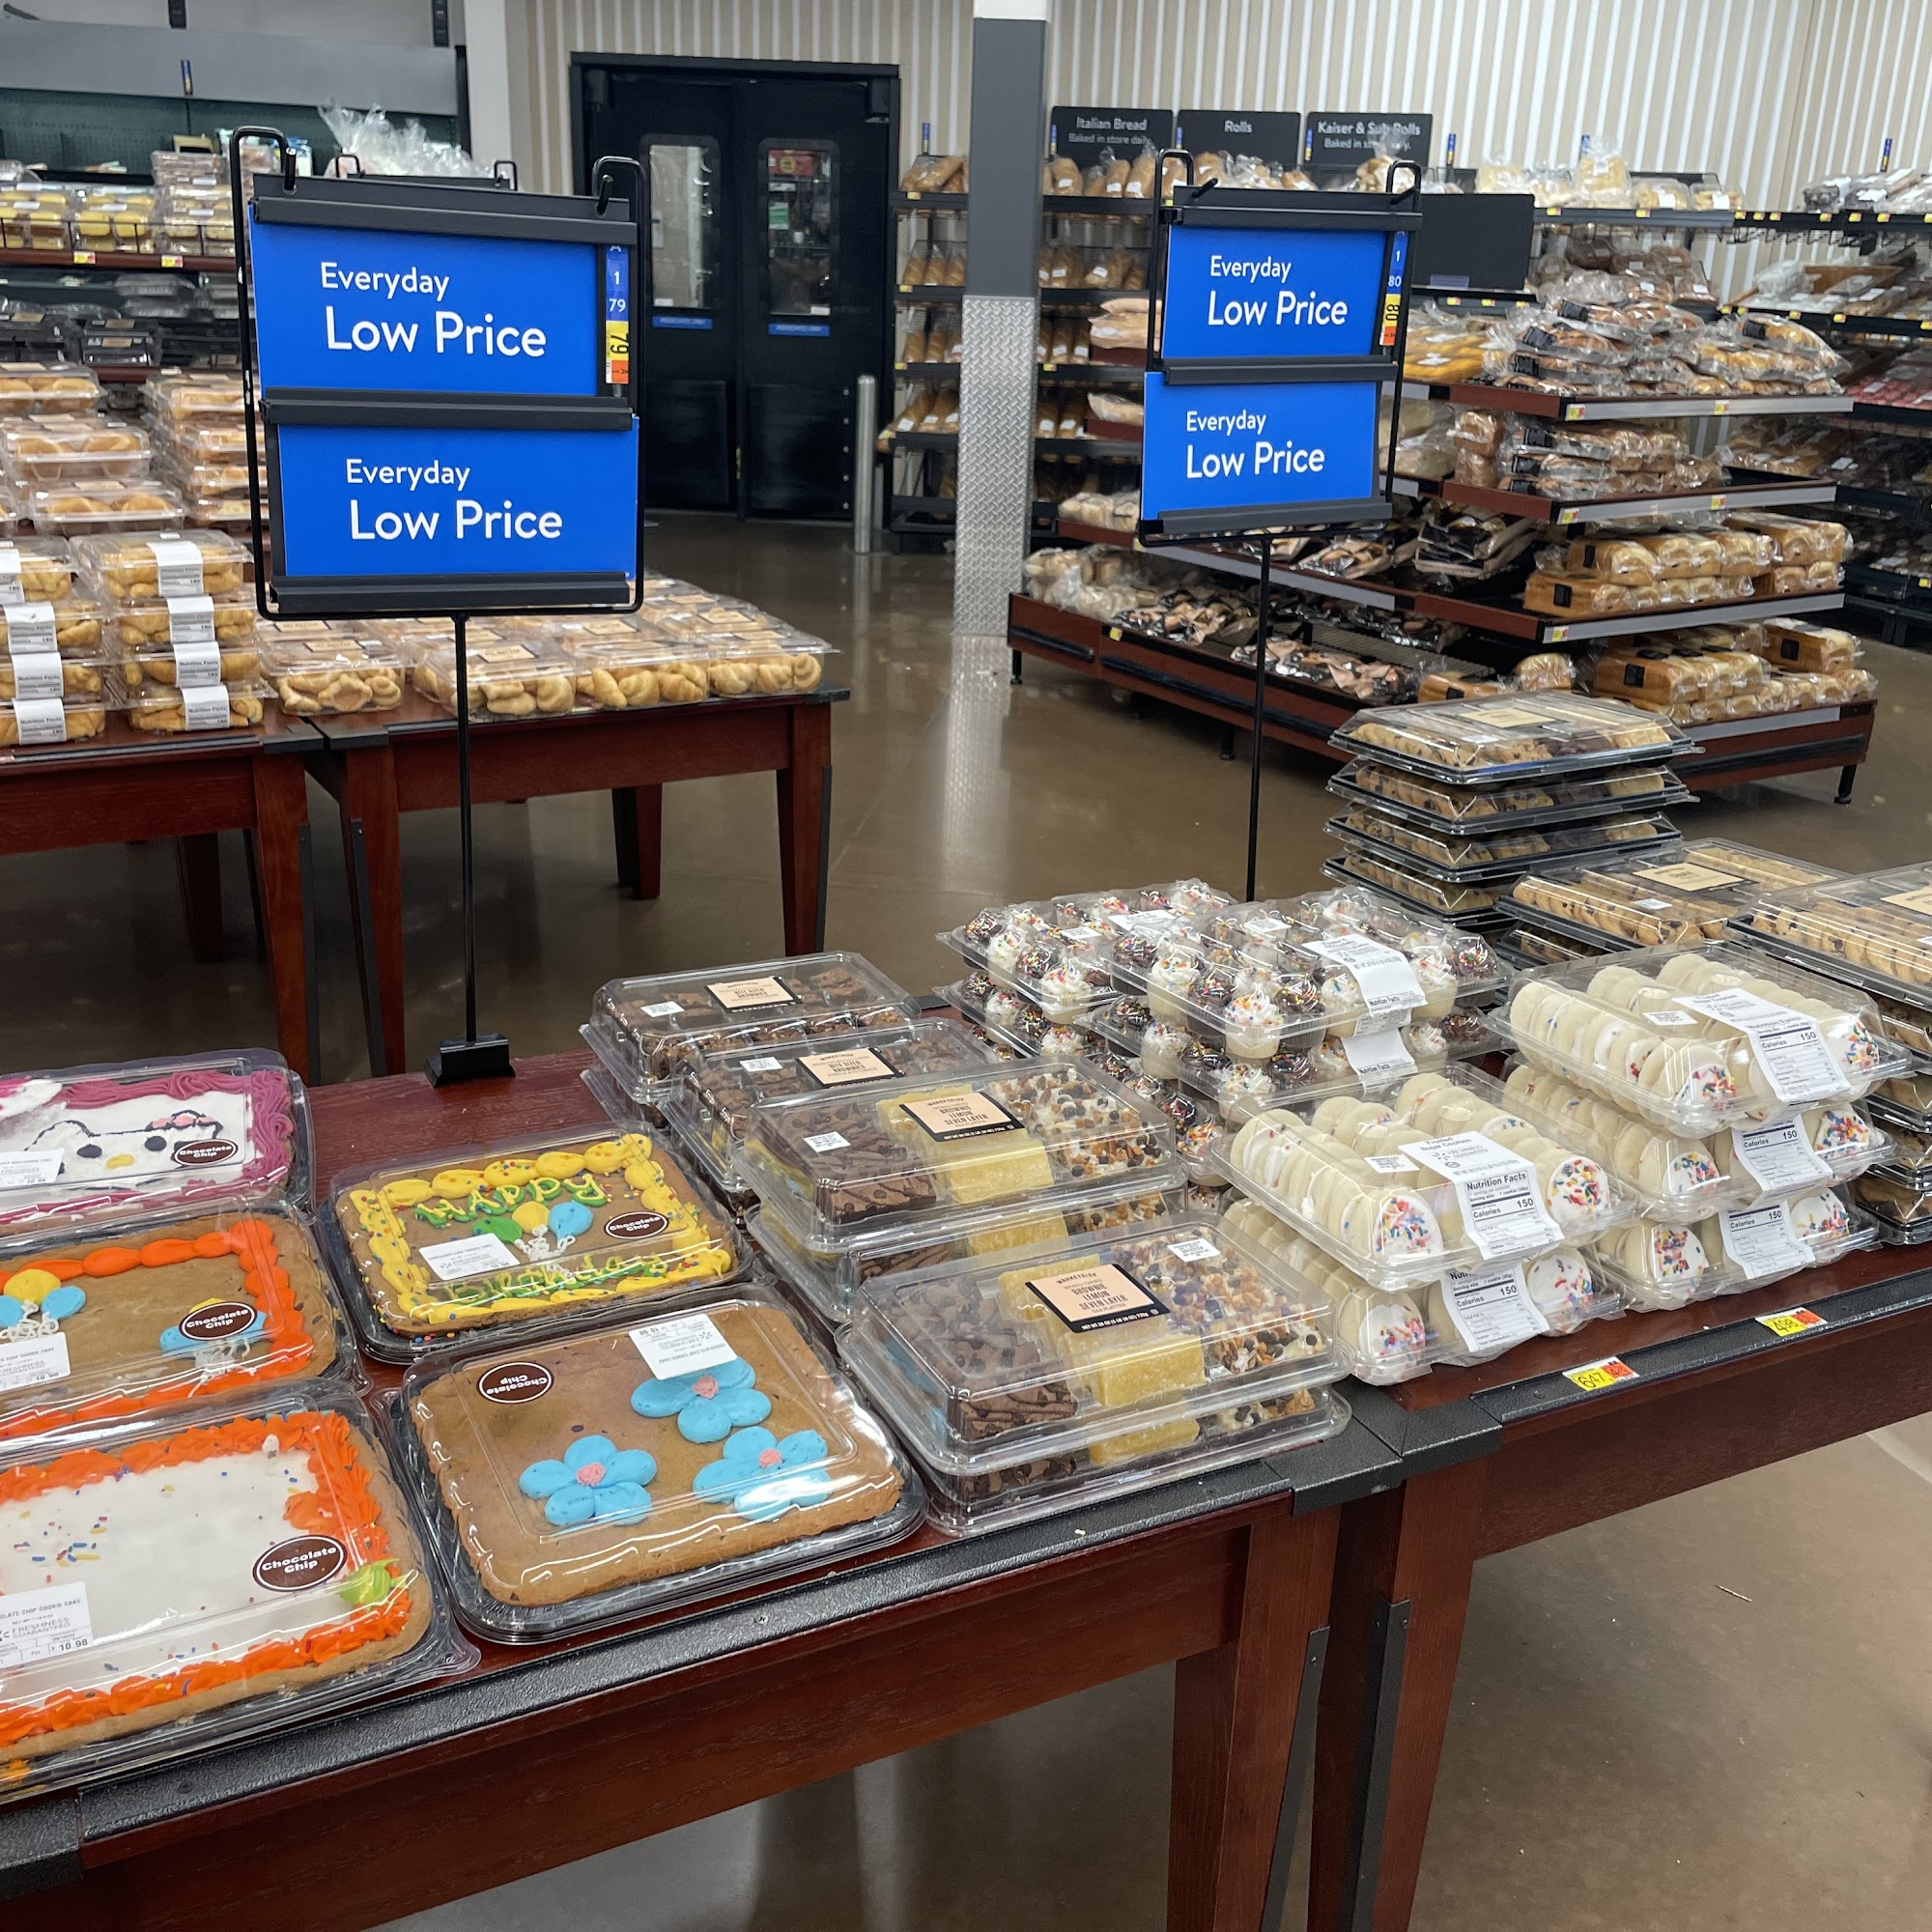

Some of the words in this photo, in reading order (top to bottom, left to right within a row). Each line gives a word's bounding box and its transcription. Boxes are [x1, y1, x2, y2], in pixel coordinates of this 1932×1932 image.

[1076, 116, 1111, 129] Italian
[1114, 118, 1148, 130] Bread
[1224, 120, 1253, 133] Rolls
[1318, 120, 1353, 134] Kaiser
[1355, 121, 1365, 134] &
[1392, 122, 1421, 135] Rolls
[1209, 255, 1293, 283] Everyday
[321, 261, 449, 301] Everyday
[613, 270, 620, 285] 1
[1388, 275, 1402, 287] 80
[609, 298, 626, 312] 79
[1208, 290, 1268, 326] Low
[1275, 290, 1349, 326] Price
[325, 305, 419, 354] Low
[435, 310, 548, 357] Price
[1186, 409, 1267, 437] Everyday
[1186, 444, 1245, 478] Low
[1254, 440, 1325, 474] Price
[346, 458, 470, 491] Everyday
[350, 498, 440, 541] Low
[455, 499, 563, 540] Price
[1762, 1040, 1787, 1049] Calories
[1800, 1032, 1816, 1040] 150
[939, 1104, 971, 1115] BROWNIE
[948, 1109, 974, 1119] LEMON
[944, 1116, 968, 1125] SEVEN
[967, 1113, 989, 1122] LAYER
[1743, 1138, 1769, 1149] Calories
[1782, 1129, 1798, 1139] 150
[180, 1146, 232, 1156] Chocolate
[1466, 1178, 1502, 1191] Nutrition
[1503, 1172, 1526, 1183] Facts
[1473, 1208, 1501, 1218] Calories
[1517, 1198, 1534, 1208] 150
[609, 1215, 662, 1231] Chocolate
[625, 1222, 650, 1233] Chip
[1730, 1219, 1755, 1229] Calories
[1768, 1210, 1781, 1220] 150
[1056, 1272, 1096, 1284] MARKETSIDE
[1071, 1283, 1108, 1295] BROWNIE
[1082, 1290, 1111, 1301] LEMON
[1453, 1284, 1470, 1293] Serving
[1457, 1295, 1485, 1308] Calories
[1500, 1285, 1517, 1296] 150
[1079, 1300, 1104, 1311] SEVEN
[1104, 1294, 1128, 1305] LAYER
[186, 1308, 248, 1328] Chocolate
[206, 1318, 234, 1330] Chip
[1773, 1319, 1799, 1333] 498
[486, 1377, 548, 1395] Chocolate
[500, 1375, 528, 1385] Chip
[1577, 1372, 1605, 1388] 647
[262, 1547, 336, 1571] Chocolate
[284, 1560, 318, 1574] Chip
[39, 1603, 63, 1611] COOKIE
[64, 1598, 81, 1606] CAKE
[13, 1616, 70, 1634] FRESHNESS
[13, 1622, 71, 1638] GUARANTEED
[59, 1638, 88, 1652] 10.98
